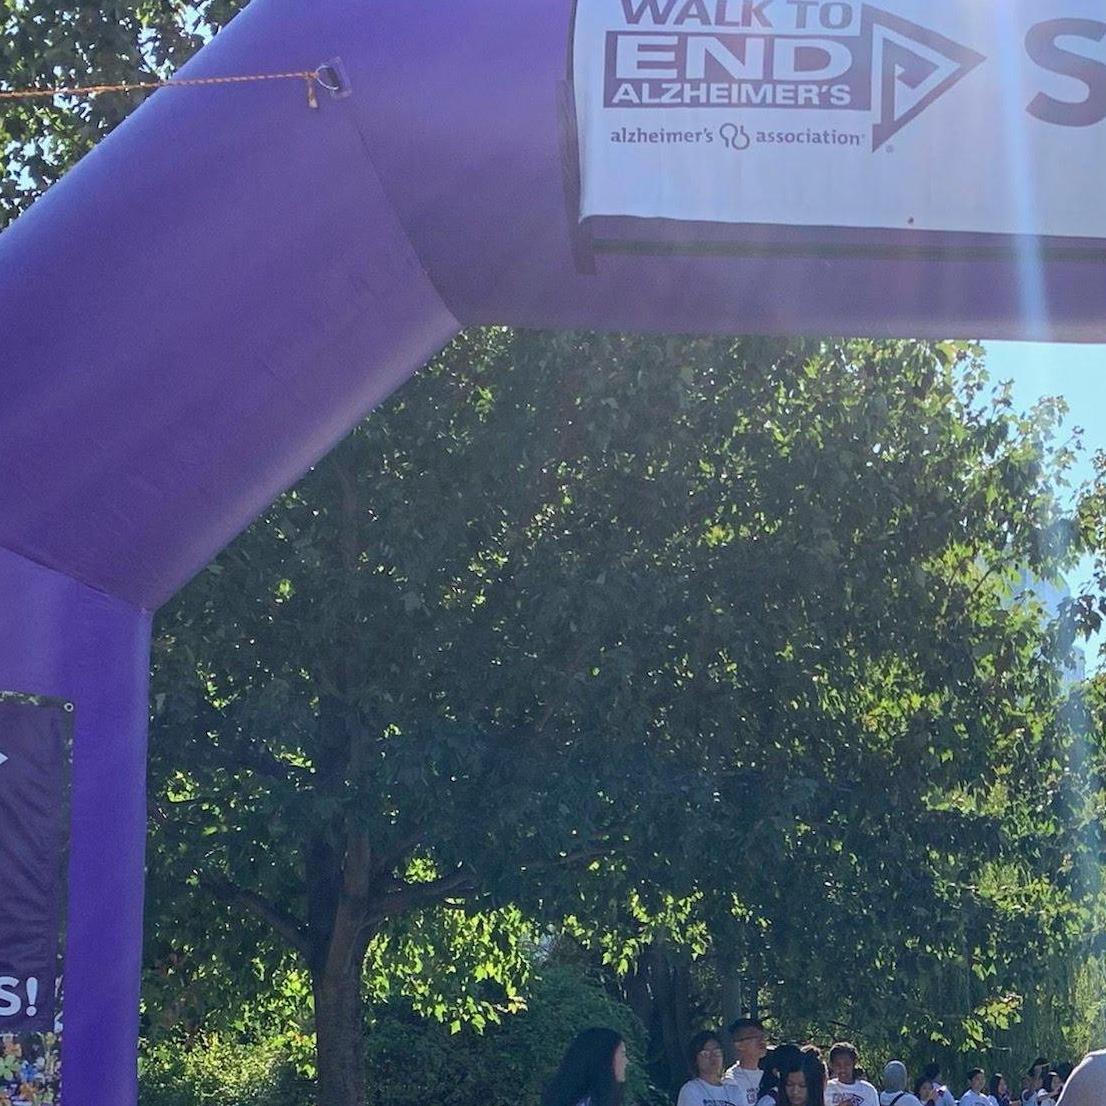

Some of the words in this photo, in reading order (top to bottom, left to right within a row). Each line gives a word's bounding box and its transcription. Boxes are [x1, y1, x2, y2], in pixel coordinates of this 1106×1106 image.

[620, 0, 774, 27] WALK
[787, 2, 854, 30] TO
[616, 35, 853, 81] END
[612, 83, 851, 106] ALZHEIMER'S
[610, 127, 714, 145] alzheimer's
[756, 128, 863, 147] association
